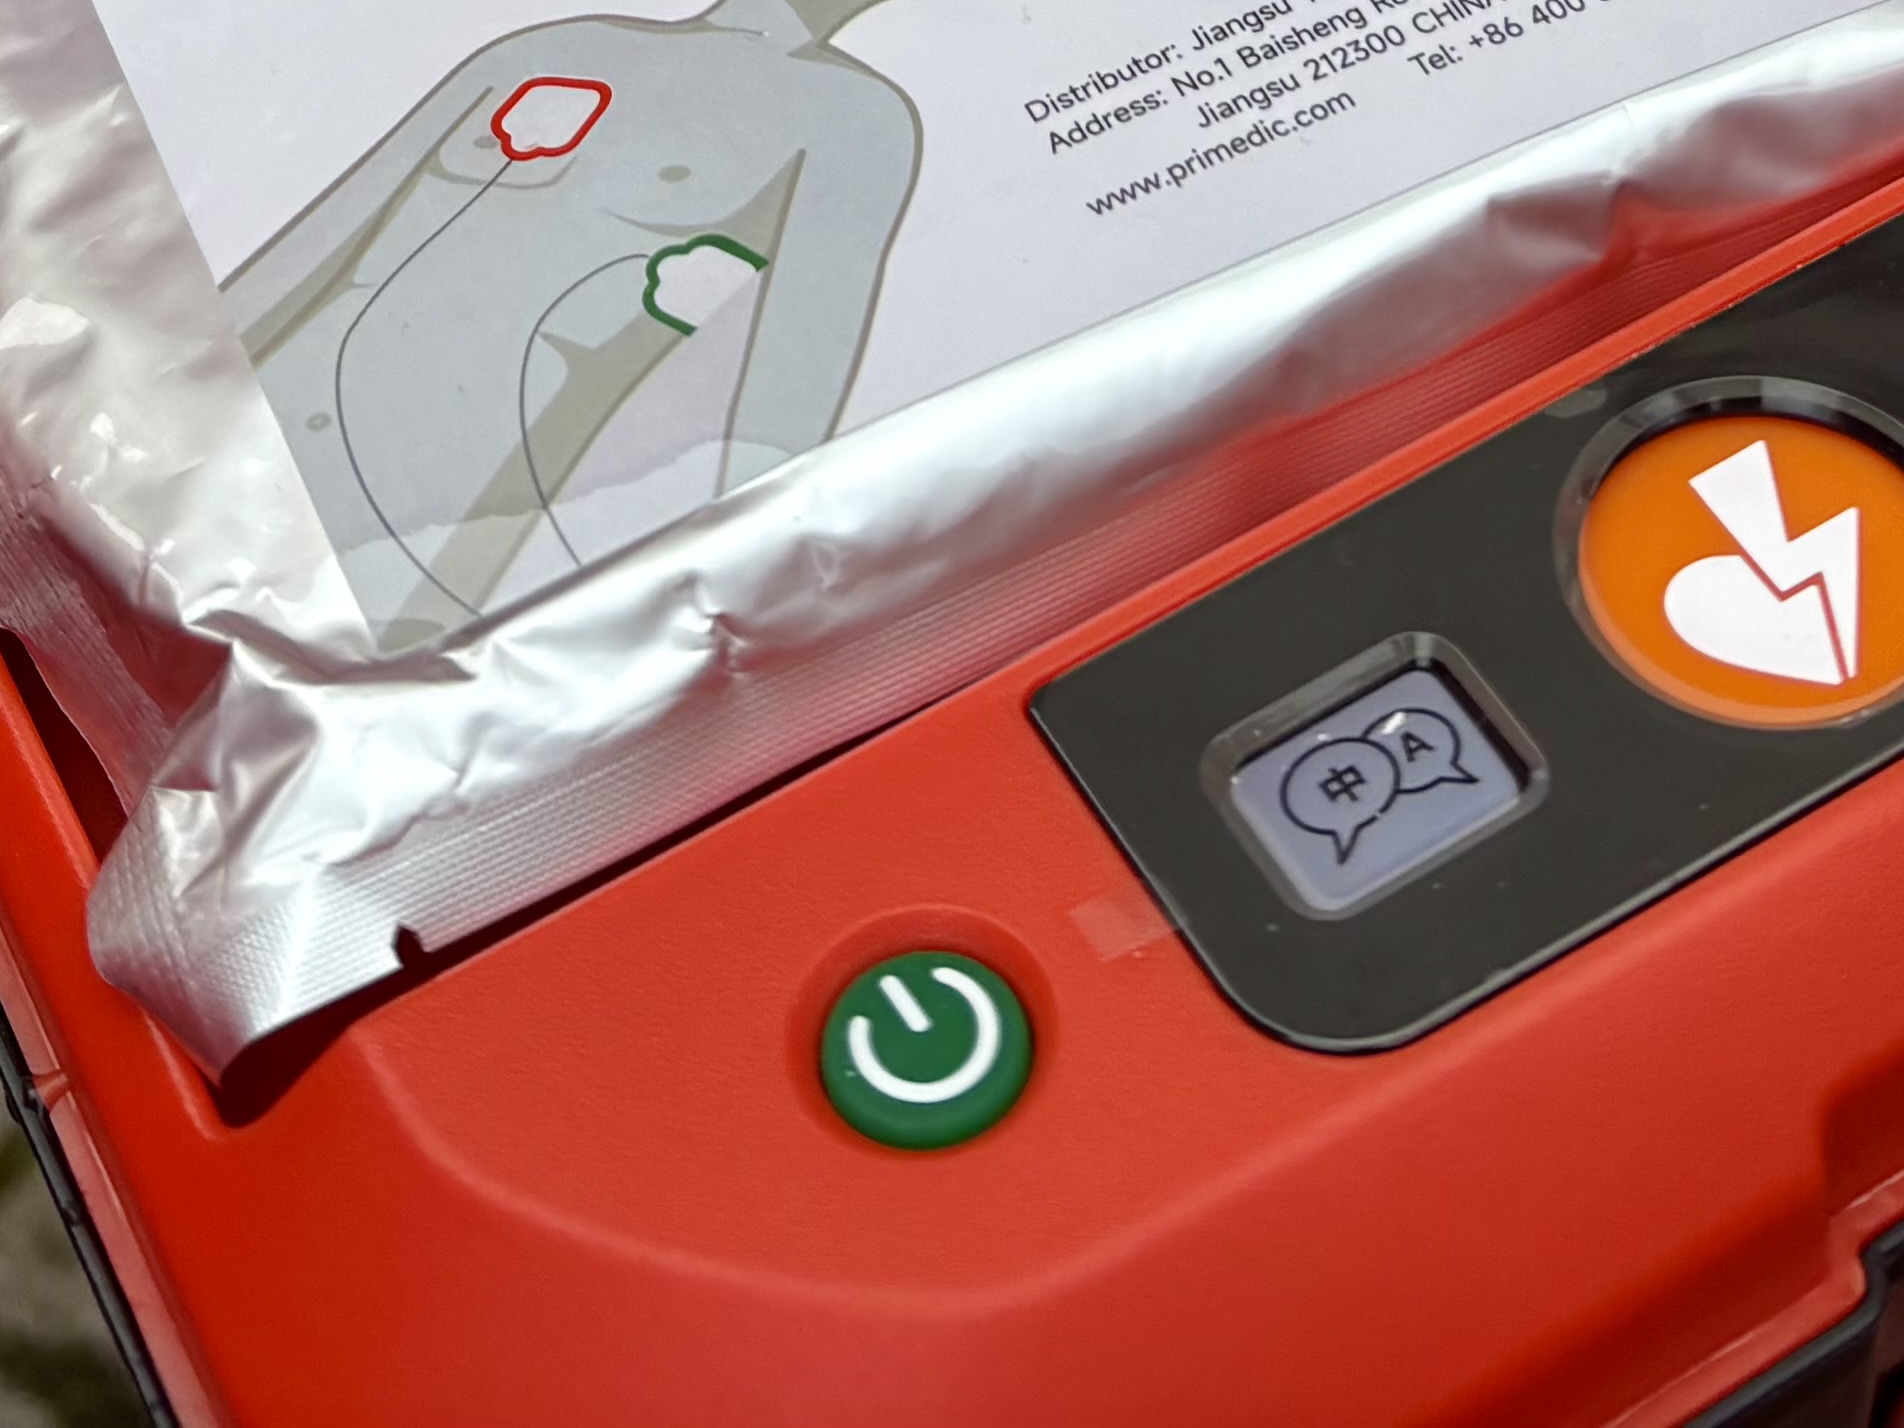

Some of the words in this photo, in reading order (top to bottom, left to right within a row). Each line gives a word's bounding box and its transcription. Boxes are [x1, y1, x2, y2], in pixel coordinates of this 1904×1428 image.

[1024, 43, 1184, 124] Distributor:
[1048, 87, 1169, 155] Address:
[1171, 57, 1234, 97] No.1
[1235, 5, 1368, 71] Baisheng
[1196, 73, 1302, 129] Jiangsu
[1303, 24, 1406, 82] 212300
[1407, 46, 1464, 78] Tel:
[1469, 16, 1525, 49] +86
[1086, 89, 1357, 217] www.primedic.com
